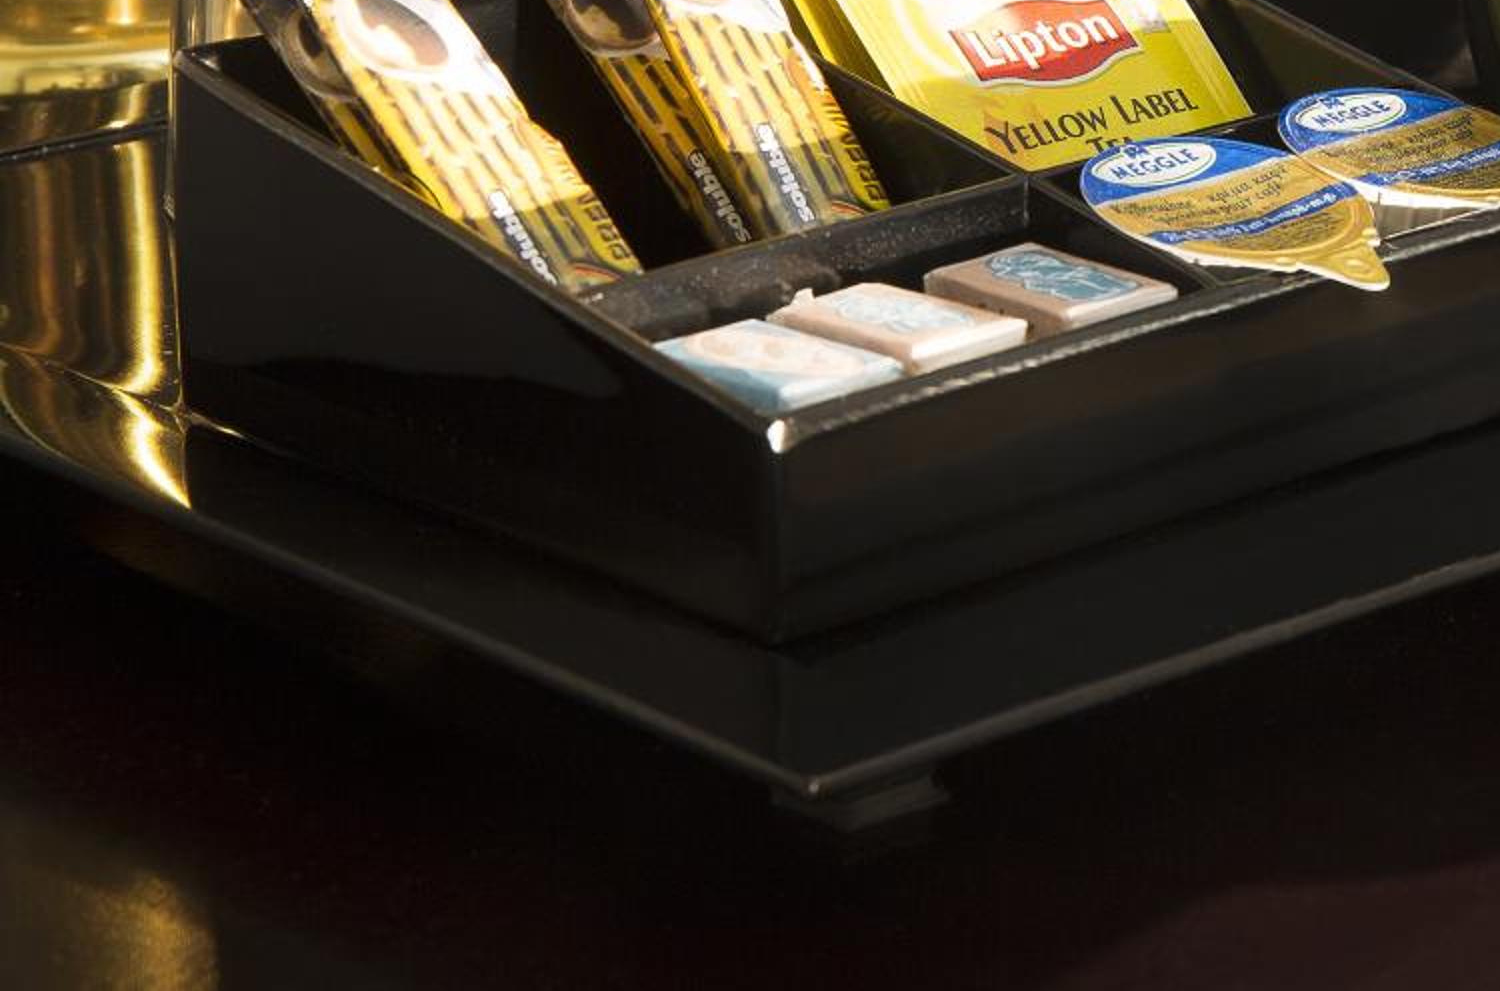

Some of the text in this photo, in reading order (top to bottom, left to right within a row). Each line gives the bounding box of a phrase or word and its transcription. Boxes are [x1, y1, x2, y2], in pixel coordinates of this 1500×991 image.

[964, 14, 1119, 71] Lipton
[984, 88, 1199, 155] YELLOW LABEL
[1311, 99, 1391, 129] MEGGLE
[756, 122, 815, 223] soluble
[1110, 148, 1199, 180] MEGGLE
[689, 150, 753, 242] soluble
